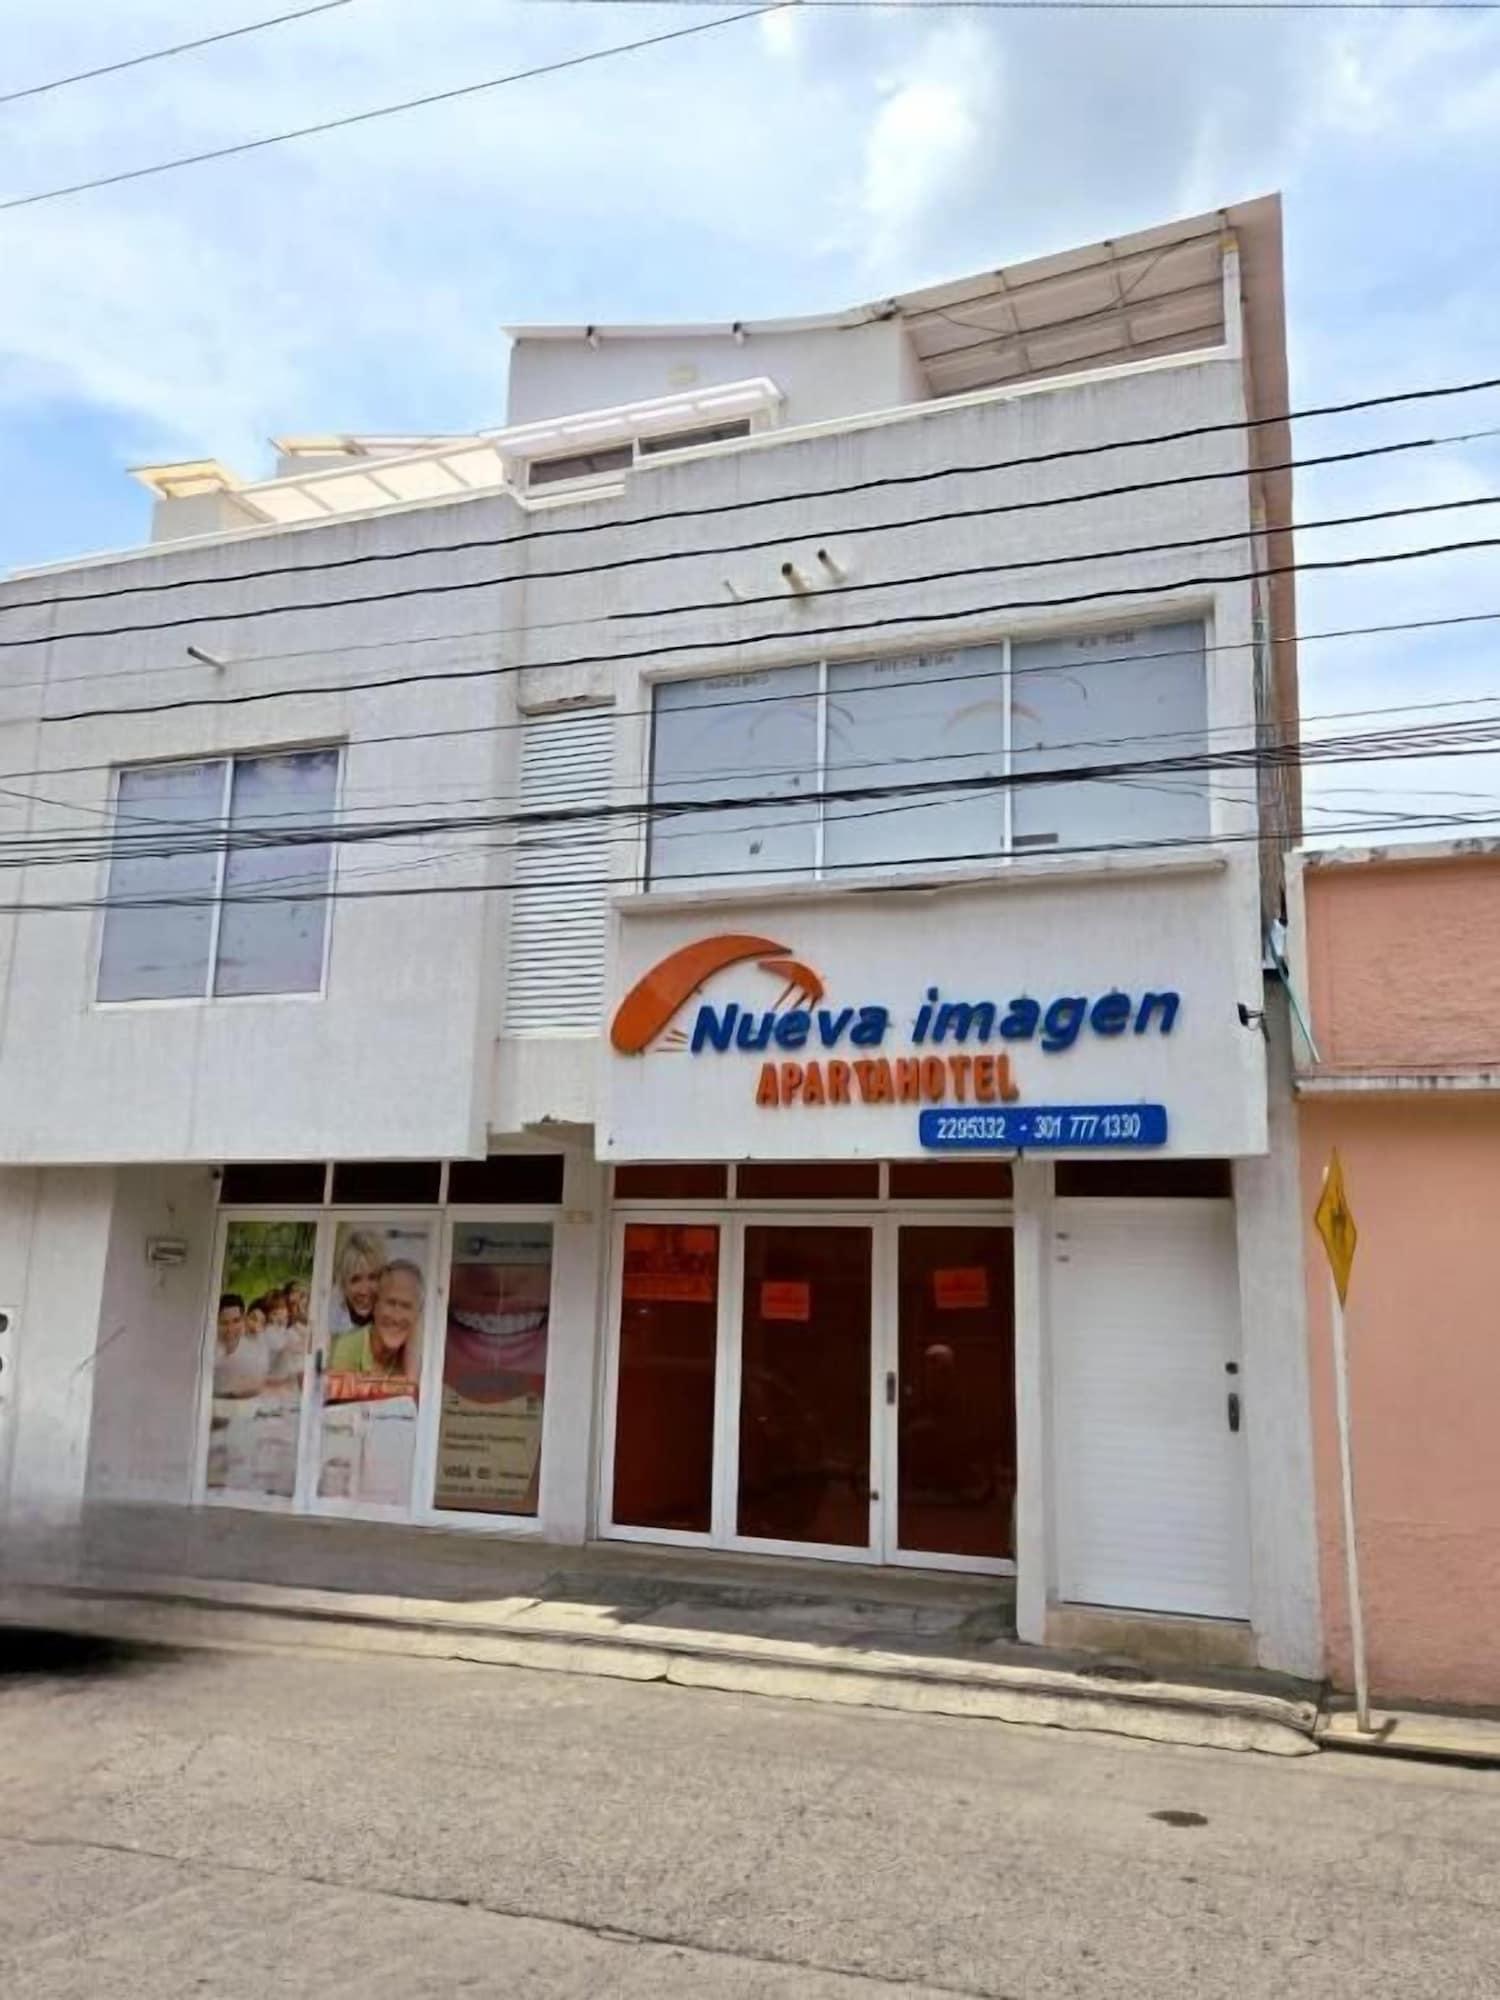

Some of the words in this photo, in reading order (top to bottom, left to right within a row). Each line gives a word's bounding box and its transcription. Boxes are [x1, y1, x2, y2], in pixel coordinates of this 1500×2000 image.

[690, 1003, 888, 1053] Nueva
[912, 987, 1180, 1052] imagen
[756, 1057, 1020, 1106] APARTAHOTEL
